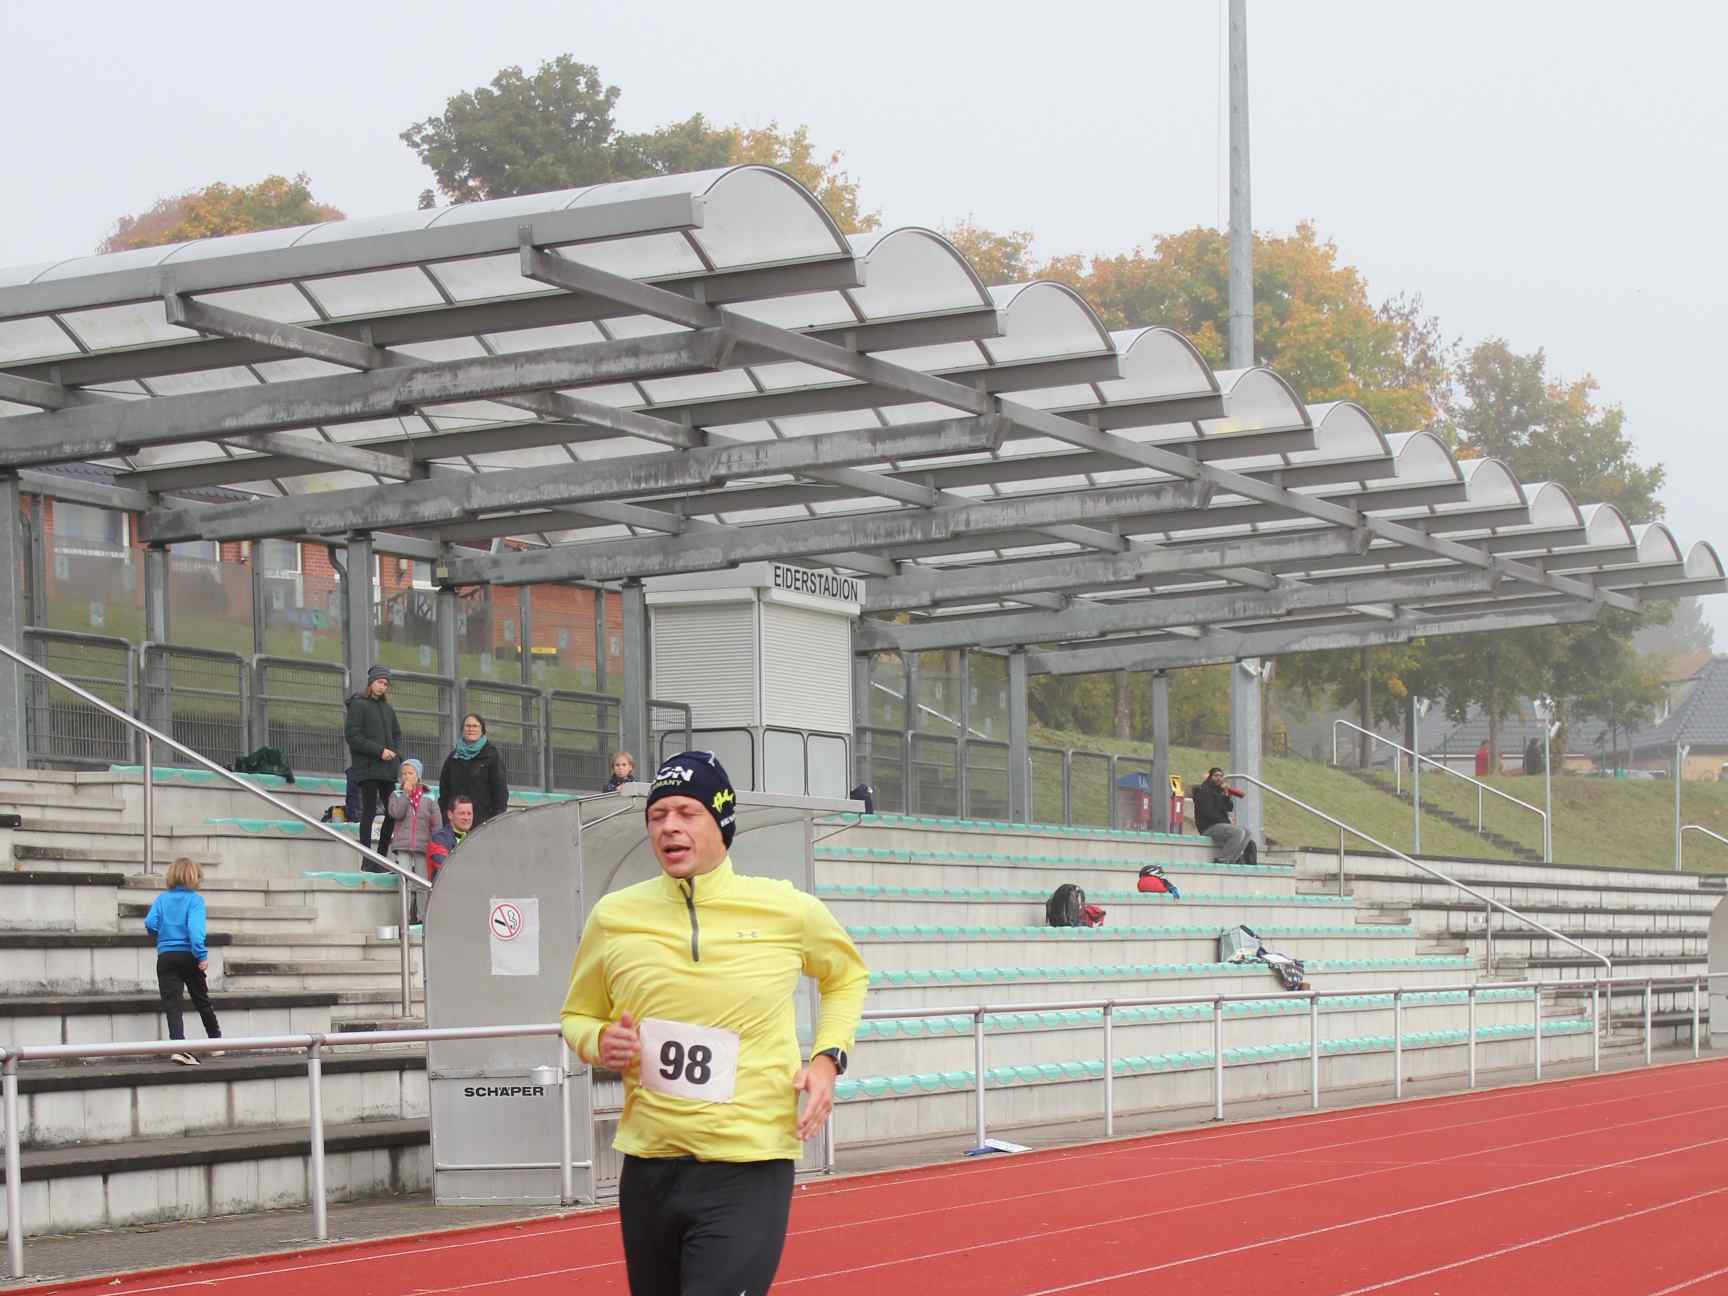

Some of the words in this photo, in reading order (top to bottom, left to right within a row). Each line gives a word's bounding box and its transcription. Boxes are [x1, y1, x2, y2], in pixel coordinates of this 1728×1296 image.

[774, 566, 858, 601] EIDERSTADION
[659, 1040, 713, 1086] 98
[464, 1086, 544, 1097] SCHÄPER
